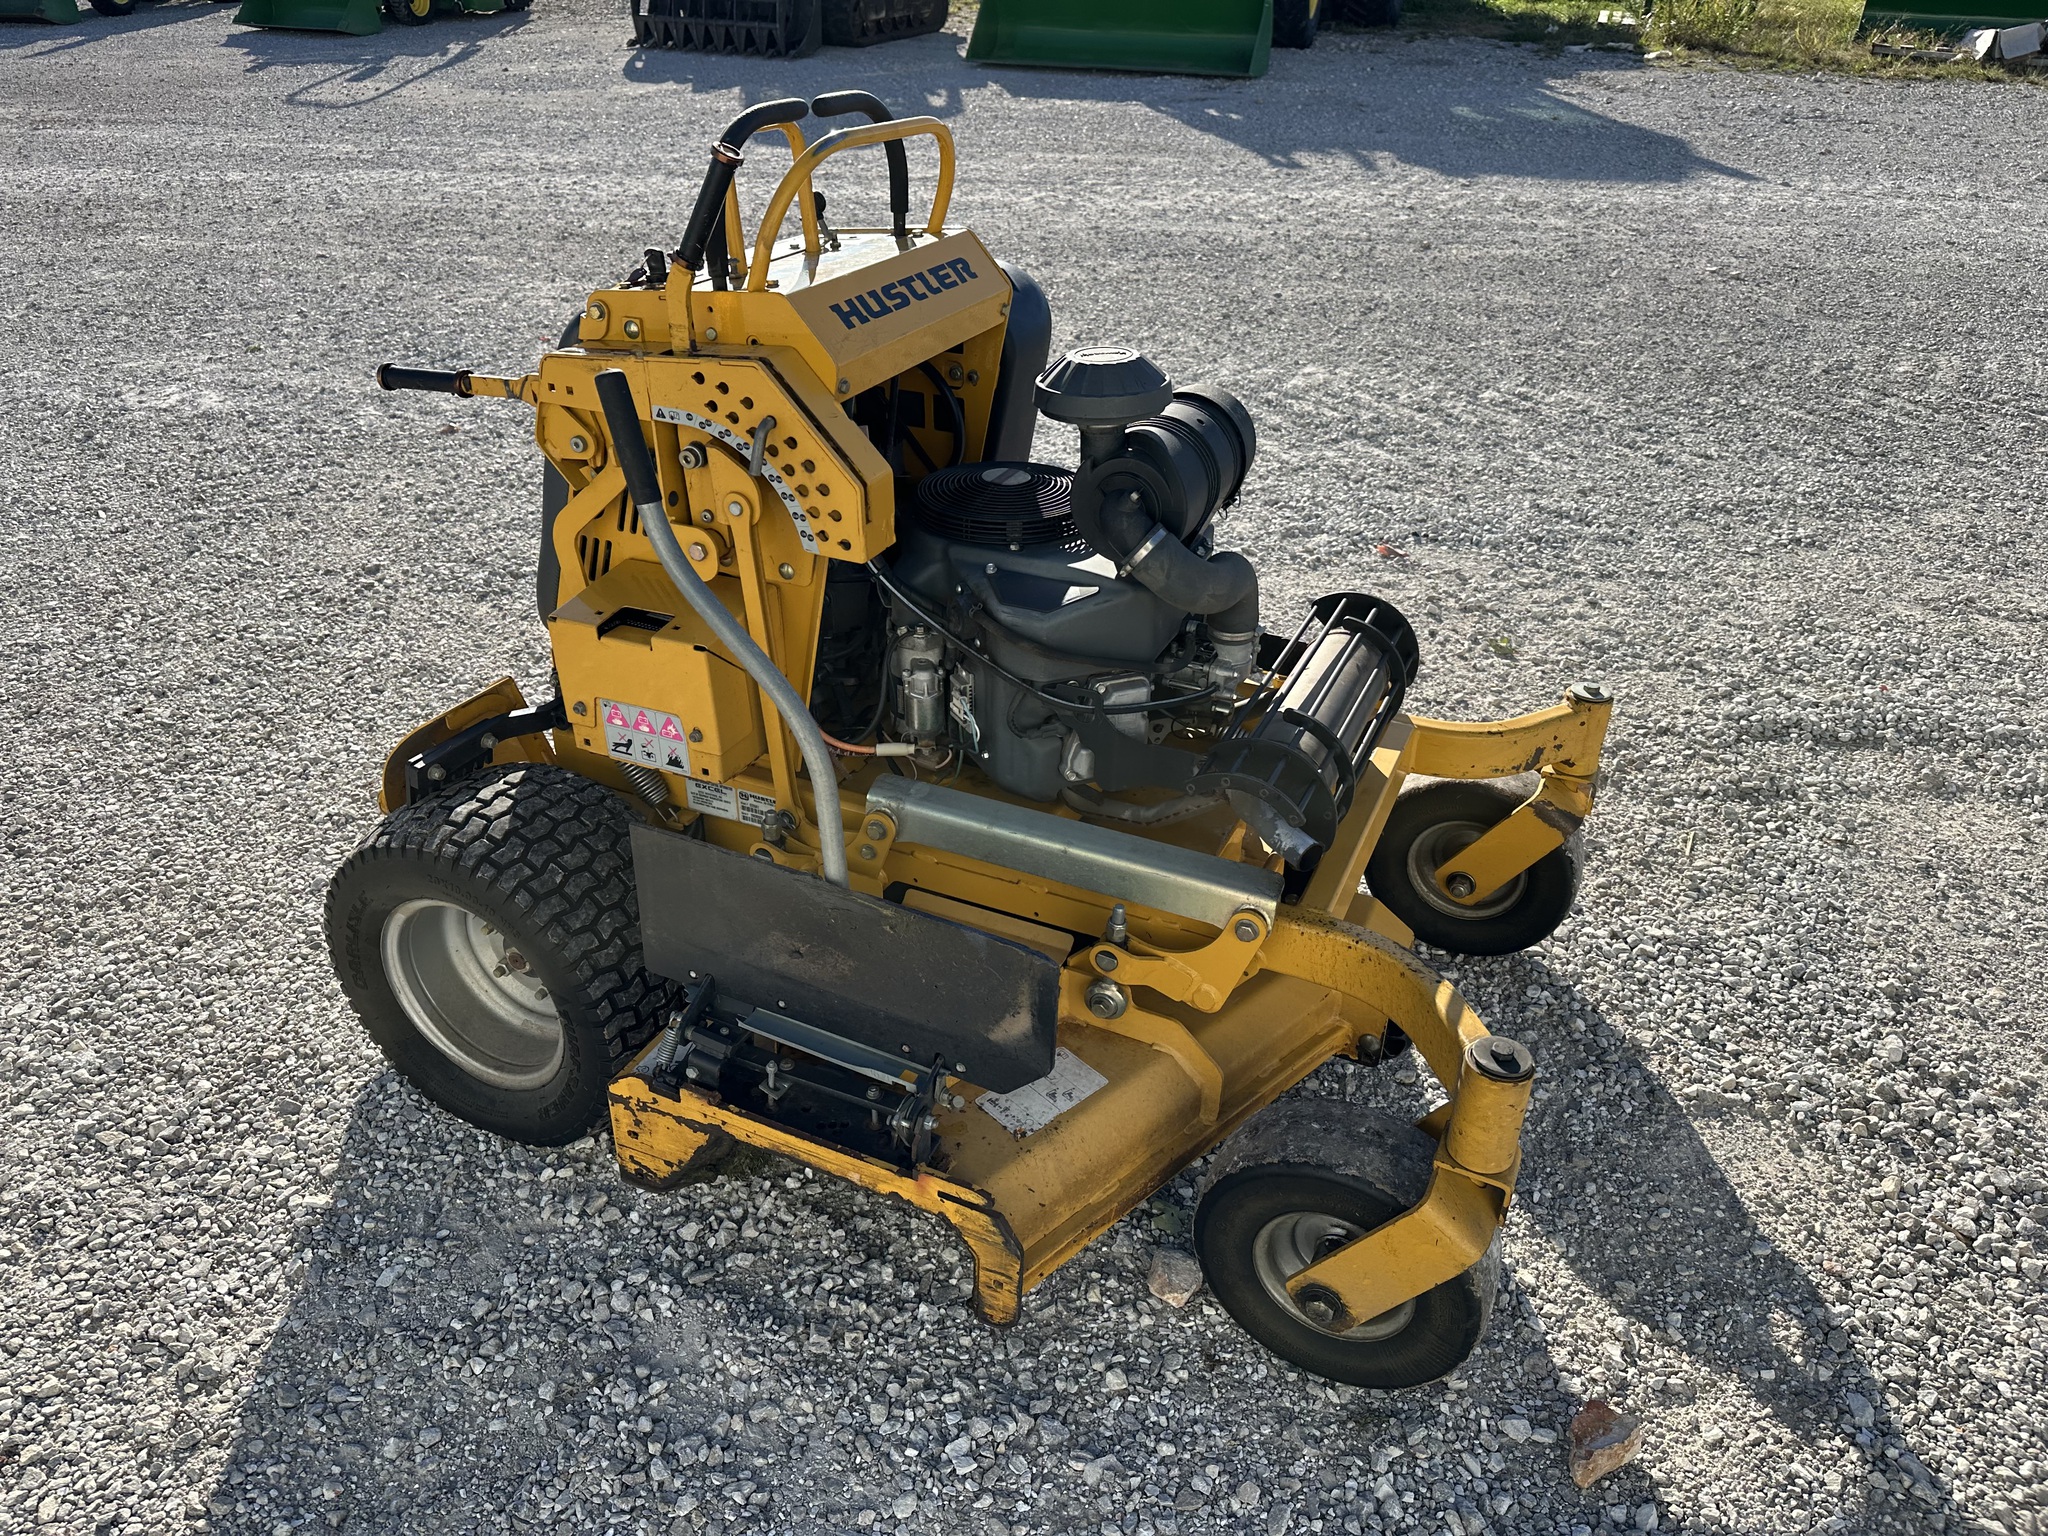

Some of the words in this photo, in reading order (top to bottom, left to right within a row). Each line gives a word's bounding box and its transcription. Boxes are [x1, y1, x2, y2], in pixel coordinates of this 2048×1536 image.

[828, 257, 979, 330] HUSTLER
[694, 782, 727, 795] EXCEL
[560, 1009, 581, 1074] TURF
[538, 1068, 579, 1119] SAVER
